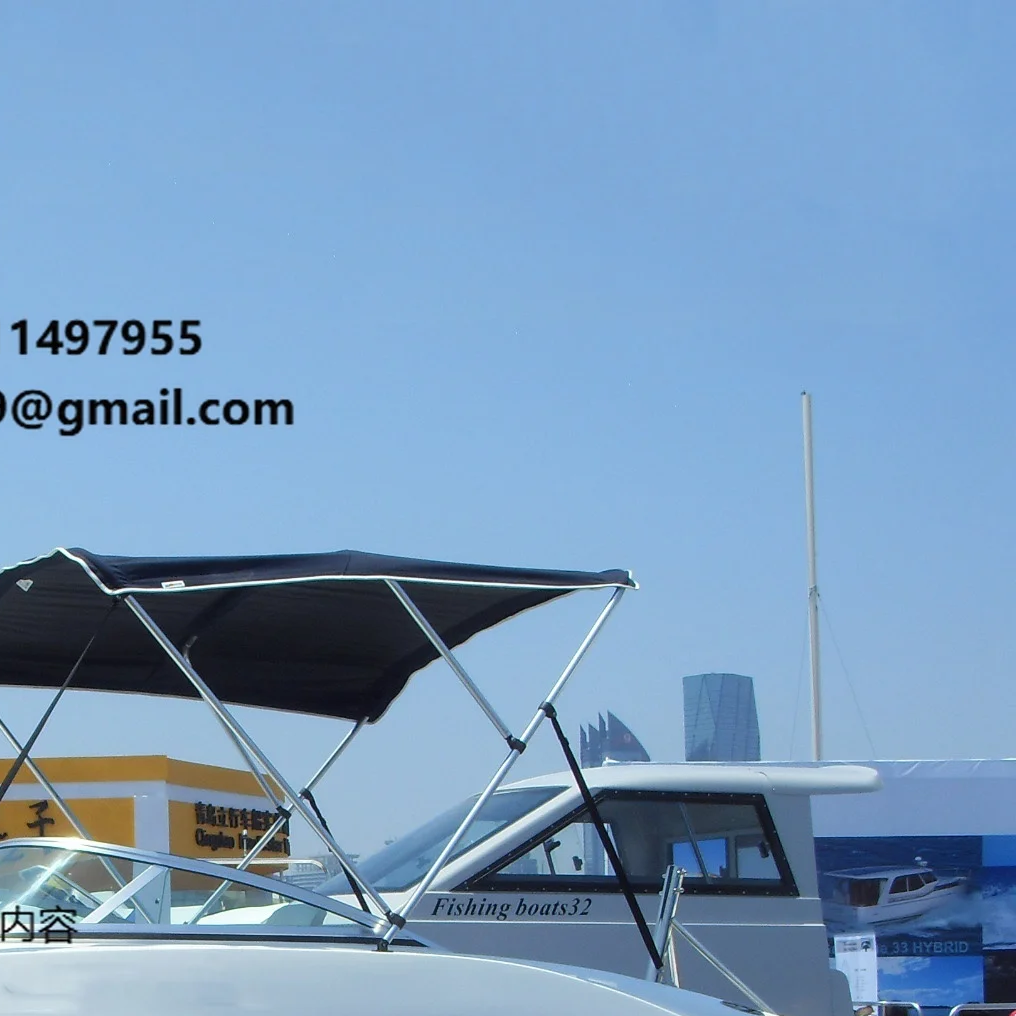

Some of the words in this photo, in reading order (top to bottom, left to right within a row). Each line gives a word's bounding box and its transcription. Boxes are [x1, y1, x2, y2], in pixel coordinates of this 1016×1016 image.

[431, 898, 511, 921] Fishing
[515, 898, 592, 916] boats32
[913, 941, 969, 953] HYBRID
